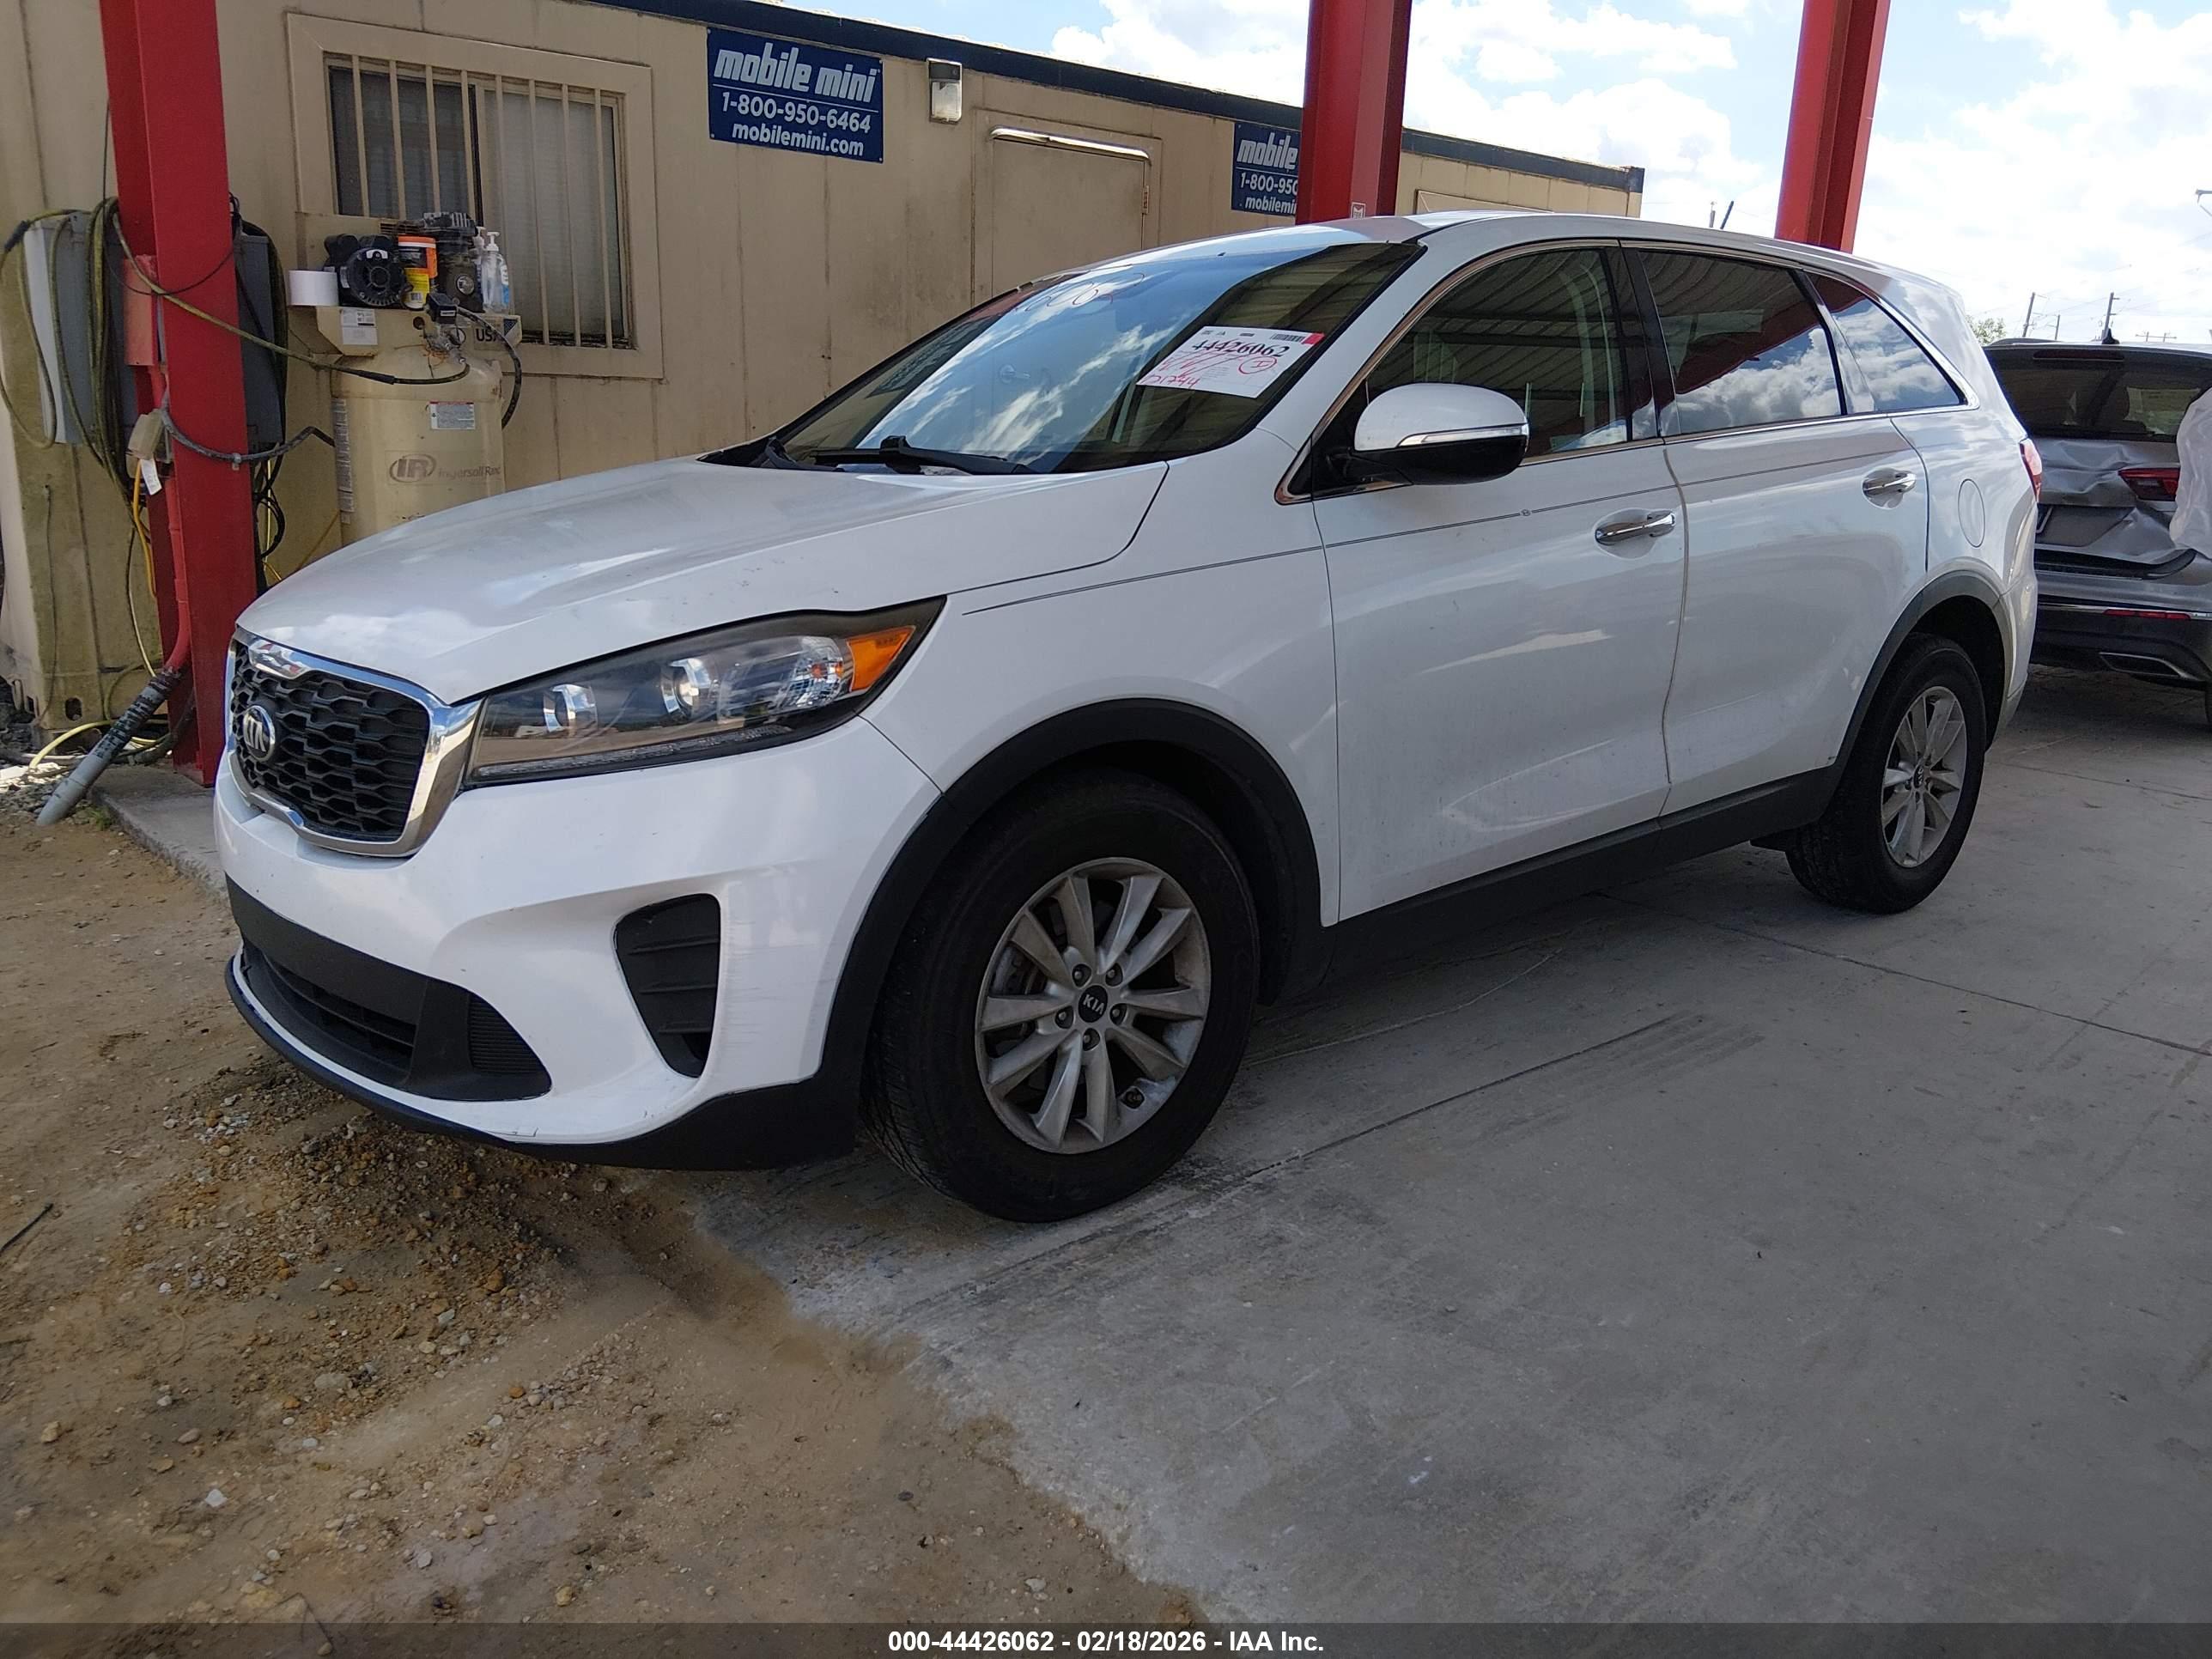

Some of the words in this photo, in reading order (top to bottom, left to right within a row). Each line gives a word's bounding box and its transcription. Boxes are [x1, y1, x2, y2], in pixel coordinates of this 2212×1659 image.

[714, 42, 812, 92] mobile
[815, 64, 878, 103] mini
[722, 91, 872, 134] 1-800-950-6464
[732, 123, 865, 156] mobilemini.com
[1237, 132, 1298, 170] mobile
[1192, 339, 1290, 358] 44426062
[1083, 994, 1105, 1015] KIA
